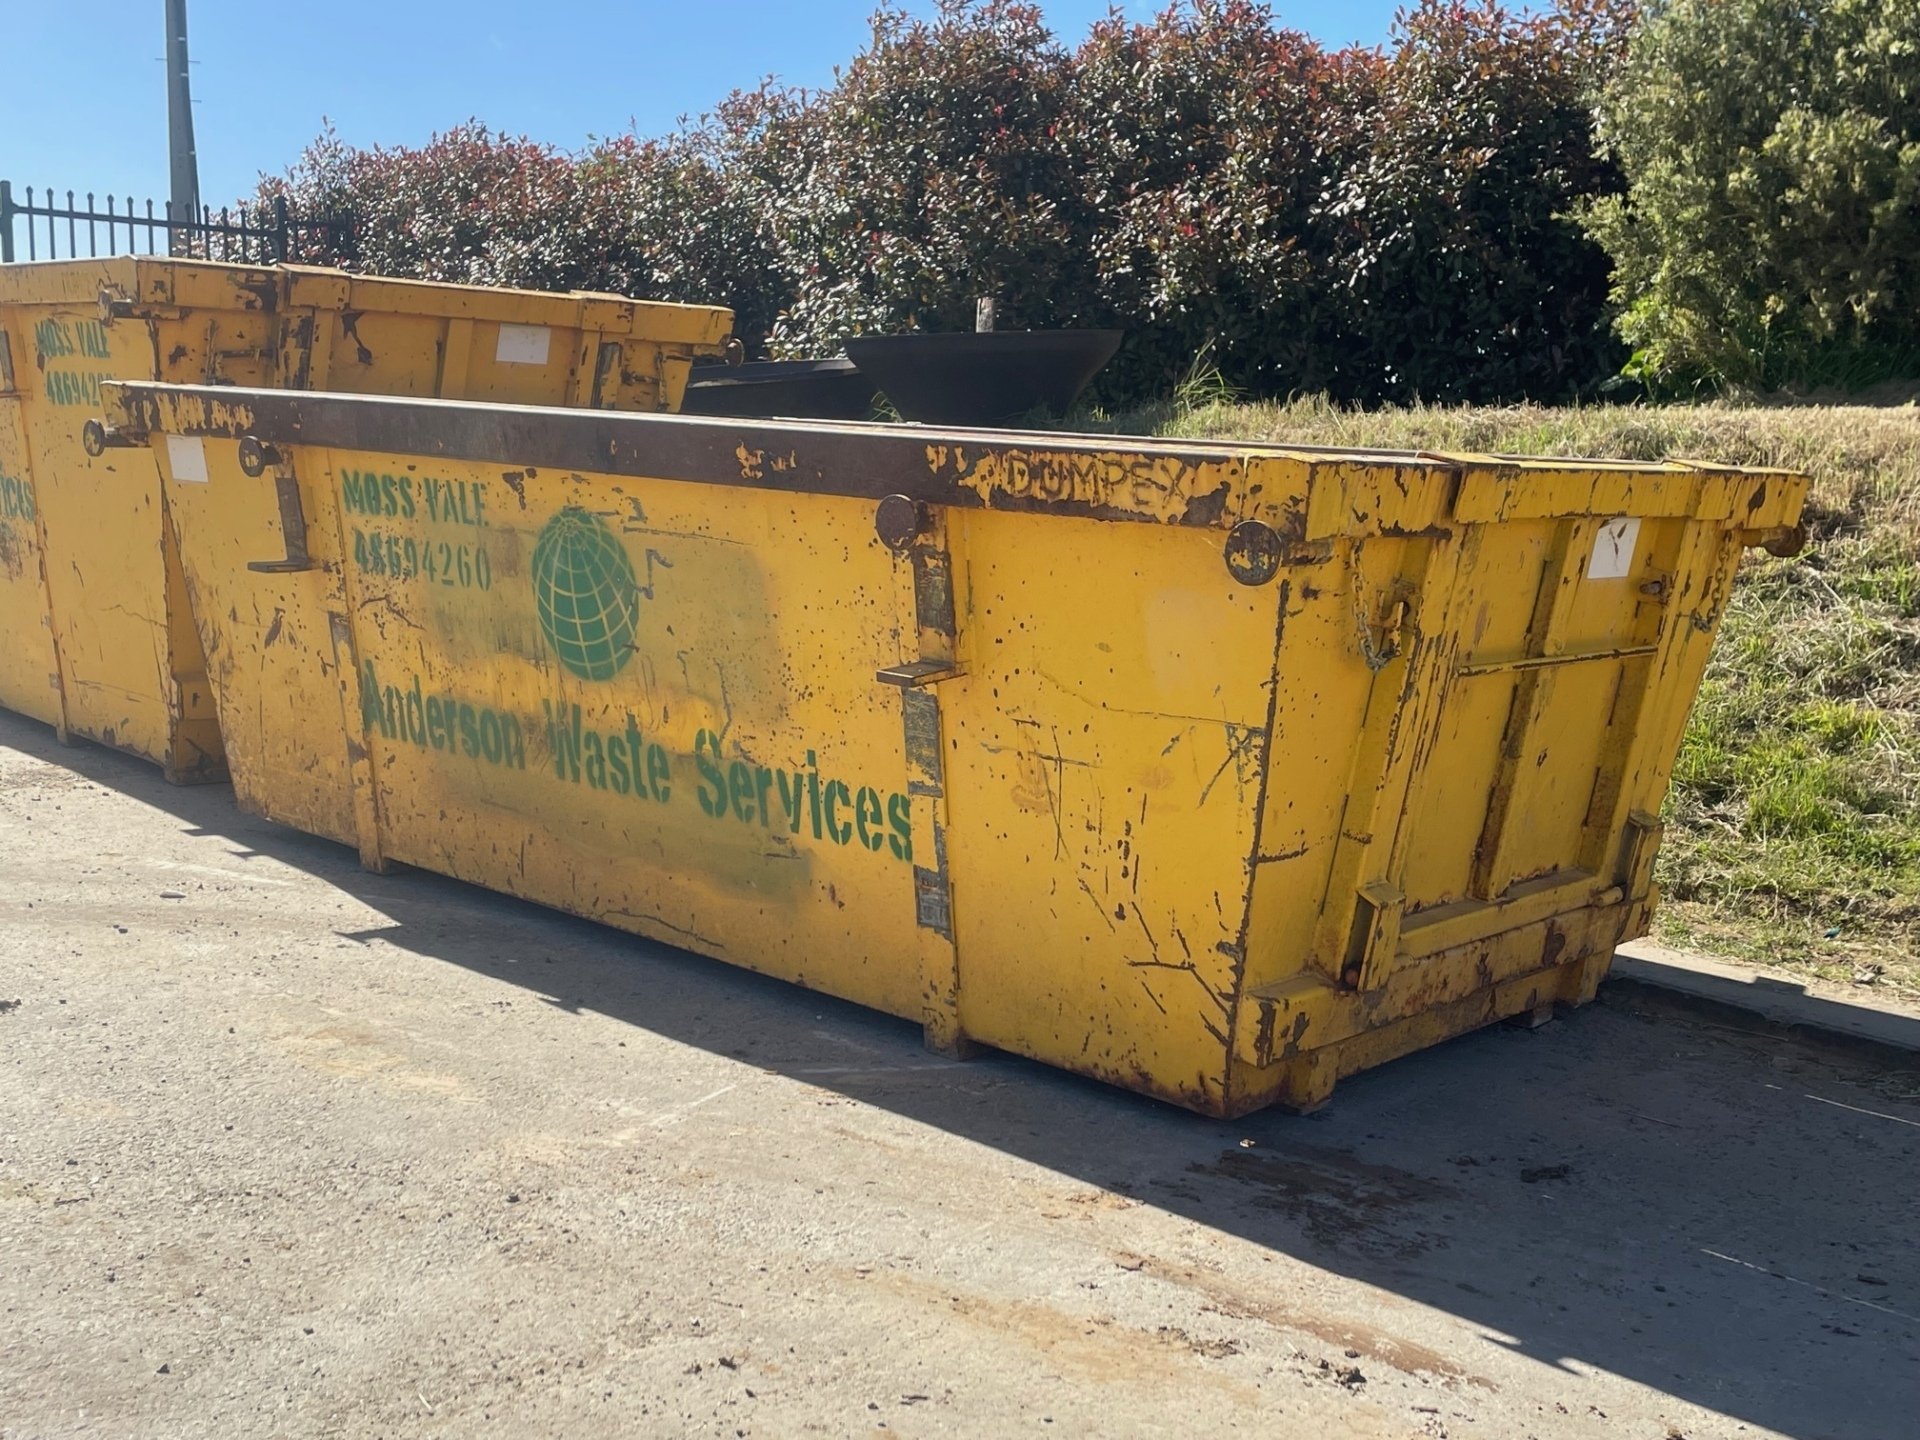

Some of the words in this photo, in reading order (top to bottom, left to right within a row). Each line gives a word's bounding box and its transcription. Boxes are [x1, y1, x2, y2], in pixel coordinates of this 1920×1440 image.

[35, 320, 73, 357] MOSS
[76, 320, 111, 358] VALE
[46, 371, 112, 406] 486942
[341, 468, 416, 519] MOSS
[423, 477, 489, 526] VALE
[1007, 454, 1187, 506] DUMPEX
[354, 528, 491, 592] 48694260
[362, 659, 526, 770] Anderson
[543, 699, 671, 803] Waste
[694, 727, 913, 862] Services
